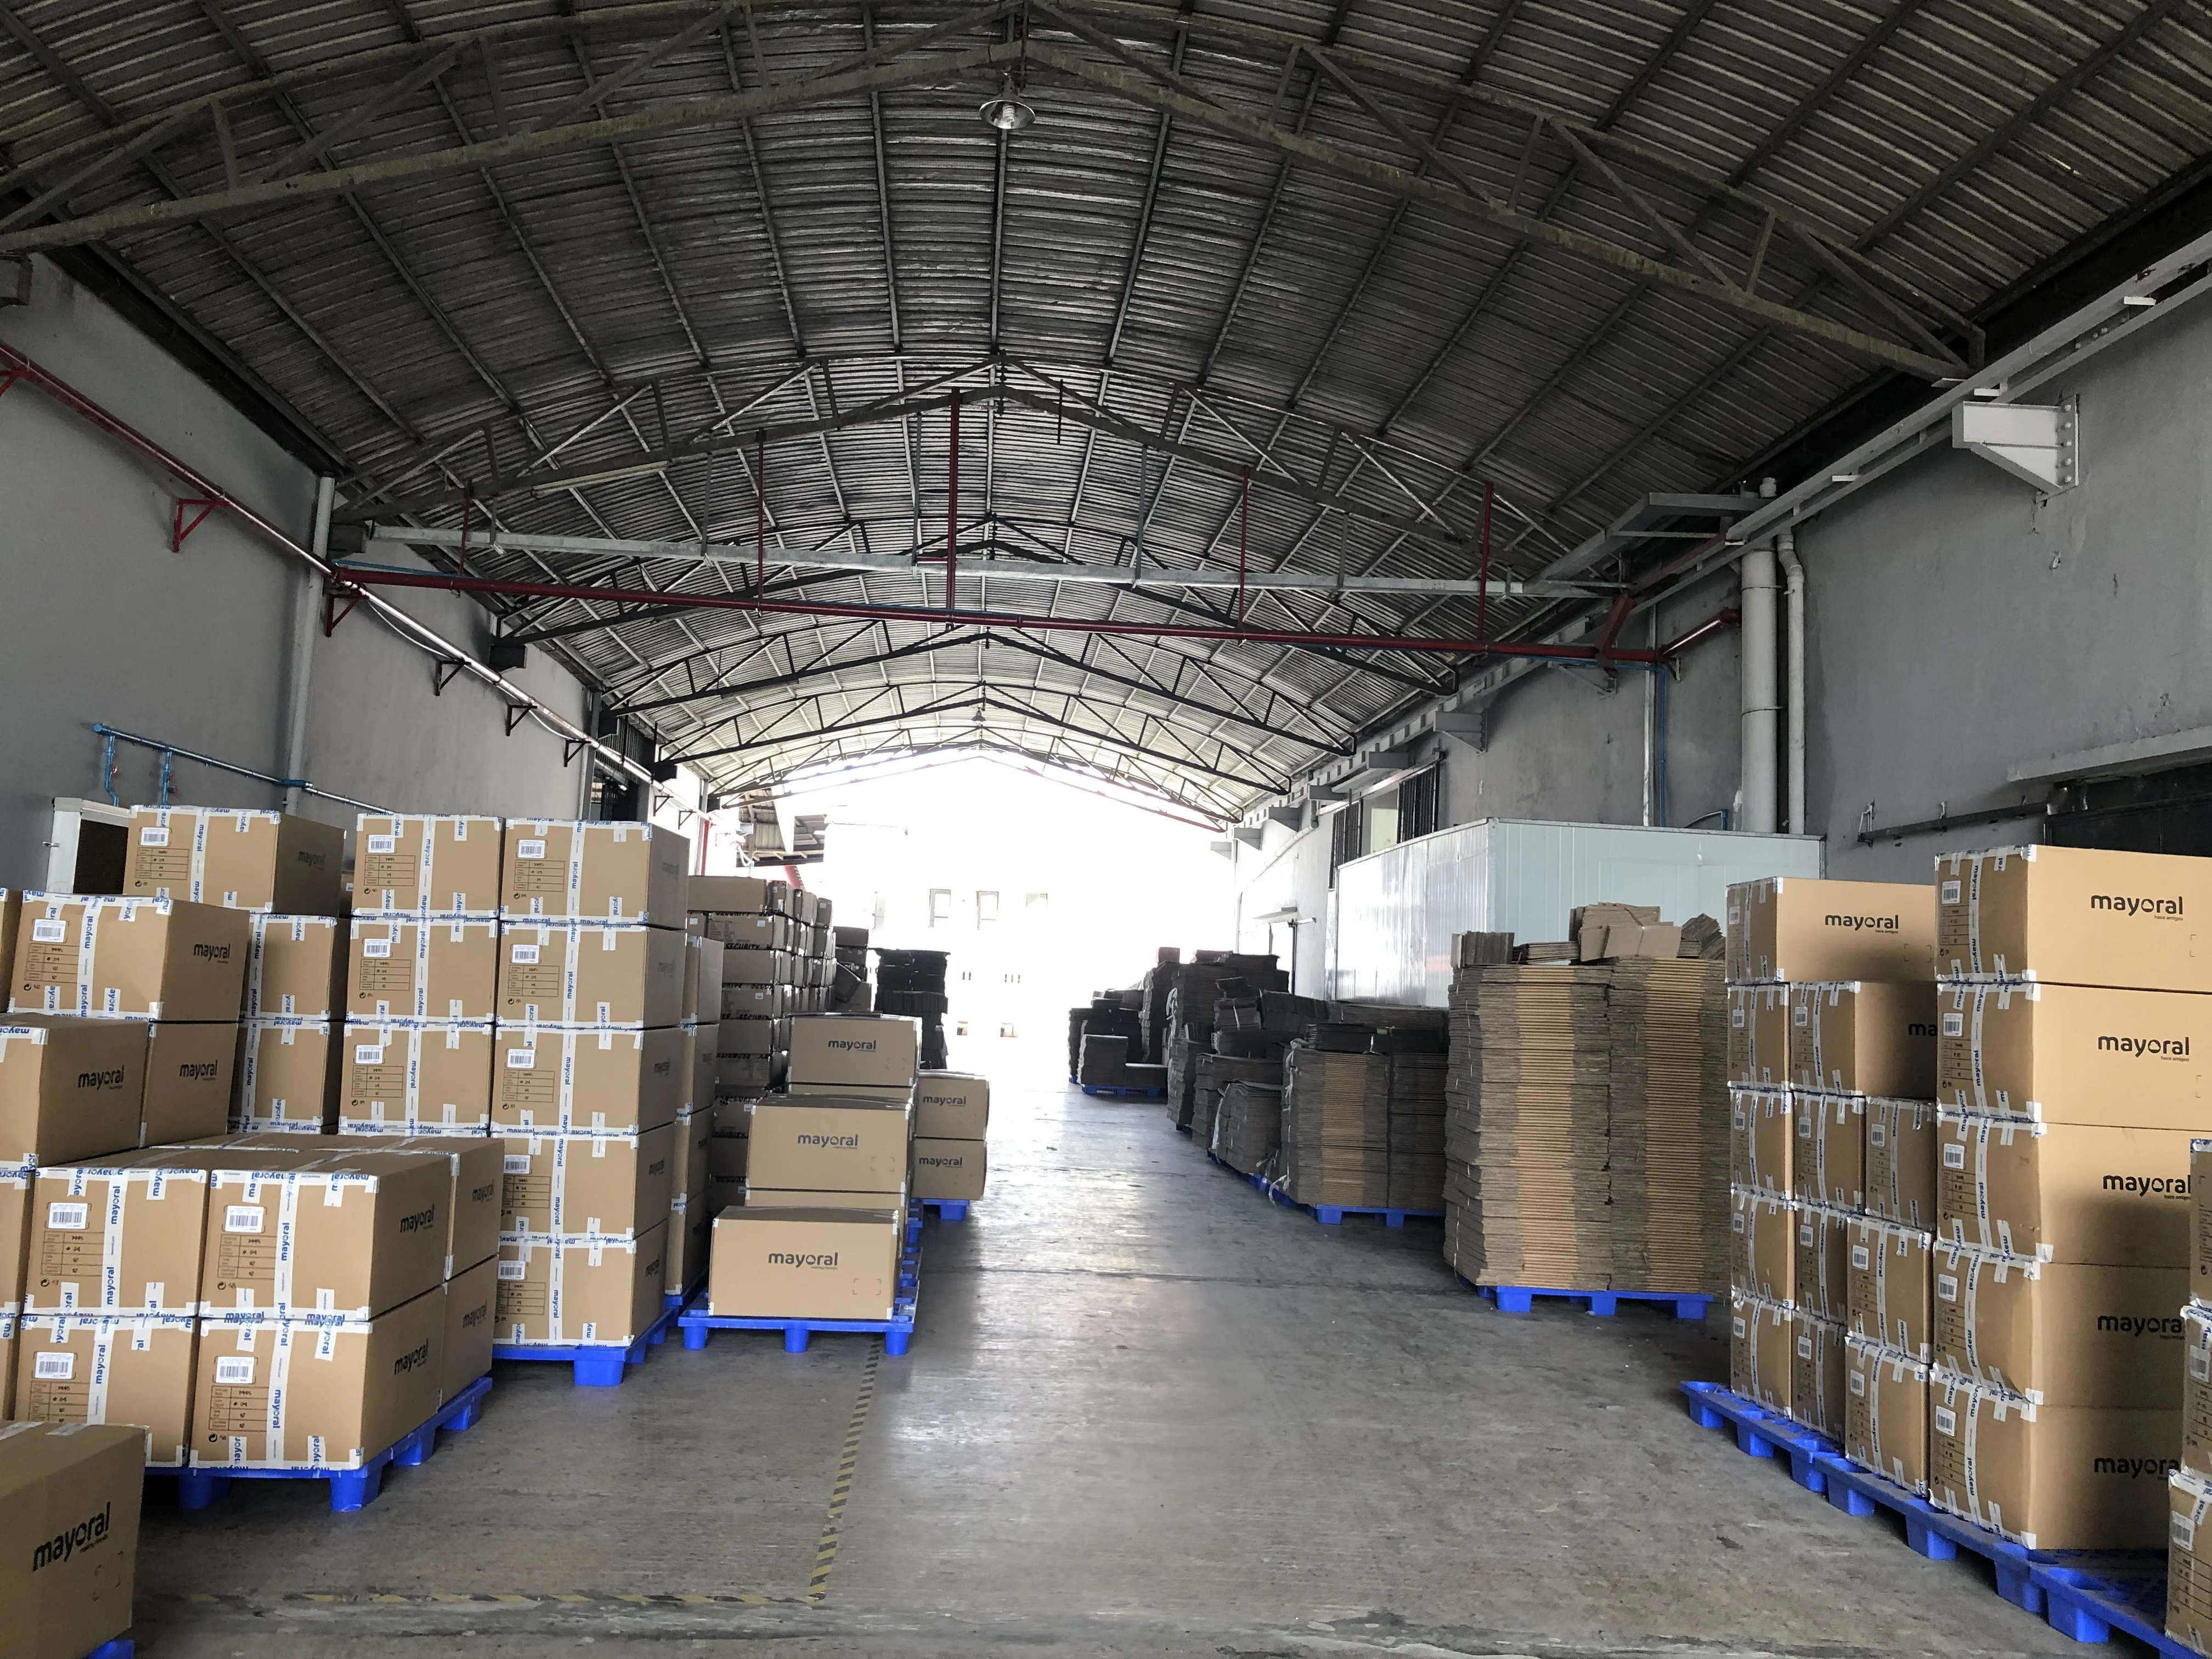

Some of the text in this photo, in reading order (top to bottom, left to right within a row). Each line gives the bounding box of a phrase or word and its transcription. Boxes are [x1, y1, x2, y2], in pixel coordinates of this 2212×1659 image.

[299, 851, 325, 867] mayoral
[2091, 895, 2183, 916] mayoral
[84, 916, 94, 949] mayoral
[1825, 915, 1898, 931] mayoral
[194, 943, 230, 961] mayoral
[1972, 938, 1980, 974] mayoral
[828, 1040, 876, 1051] mayoral
[2098, 1036, 2189, 1058] mayoral
[78, 1065, 124, 1090] mayoral
[179, 1059, 217, 1081] mayoral
[923, 1096, 966, 1105] mayoral
[797, 1134, 858, 1148] mayoral
[919, 1157, 963, 1167] mayoral
[330, 1173, 369, 1182] mayoral
[2103, 1173, 2191, 1197] mayoral
[111, 1186, 121, 1224] mayoral
[400, 1204, 435, 1233] mayoral
[281, 1222, 290, 1261] mayoral
[768, 1252, 838, 1268] mayoral
[1969, 1254, 1979, 1290] mayoral
[2097, 1316, 2183, 1337] mayora
[394, 1337, 428, 1376] mayoral
[1967, 1329, 1977, 1368] mayoral
[96, 1344, 106, 1384] mayoral
[1872, 1349, 1883, 1381] mayoral
[273, 1389, 281, 1429] mayoral
[2094, 1457, 2180, 1479] mayora
[32, 1501, 111, 1572] mayoral
